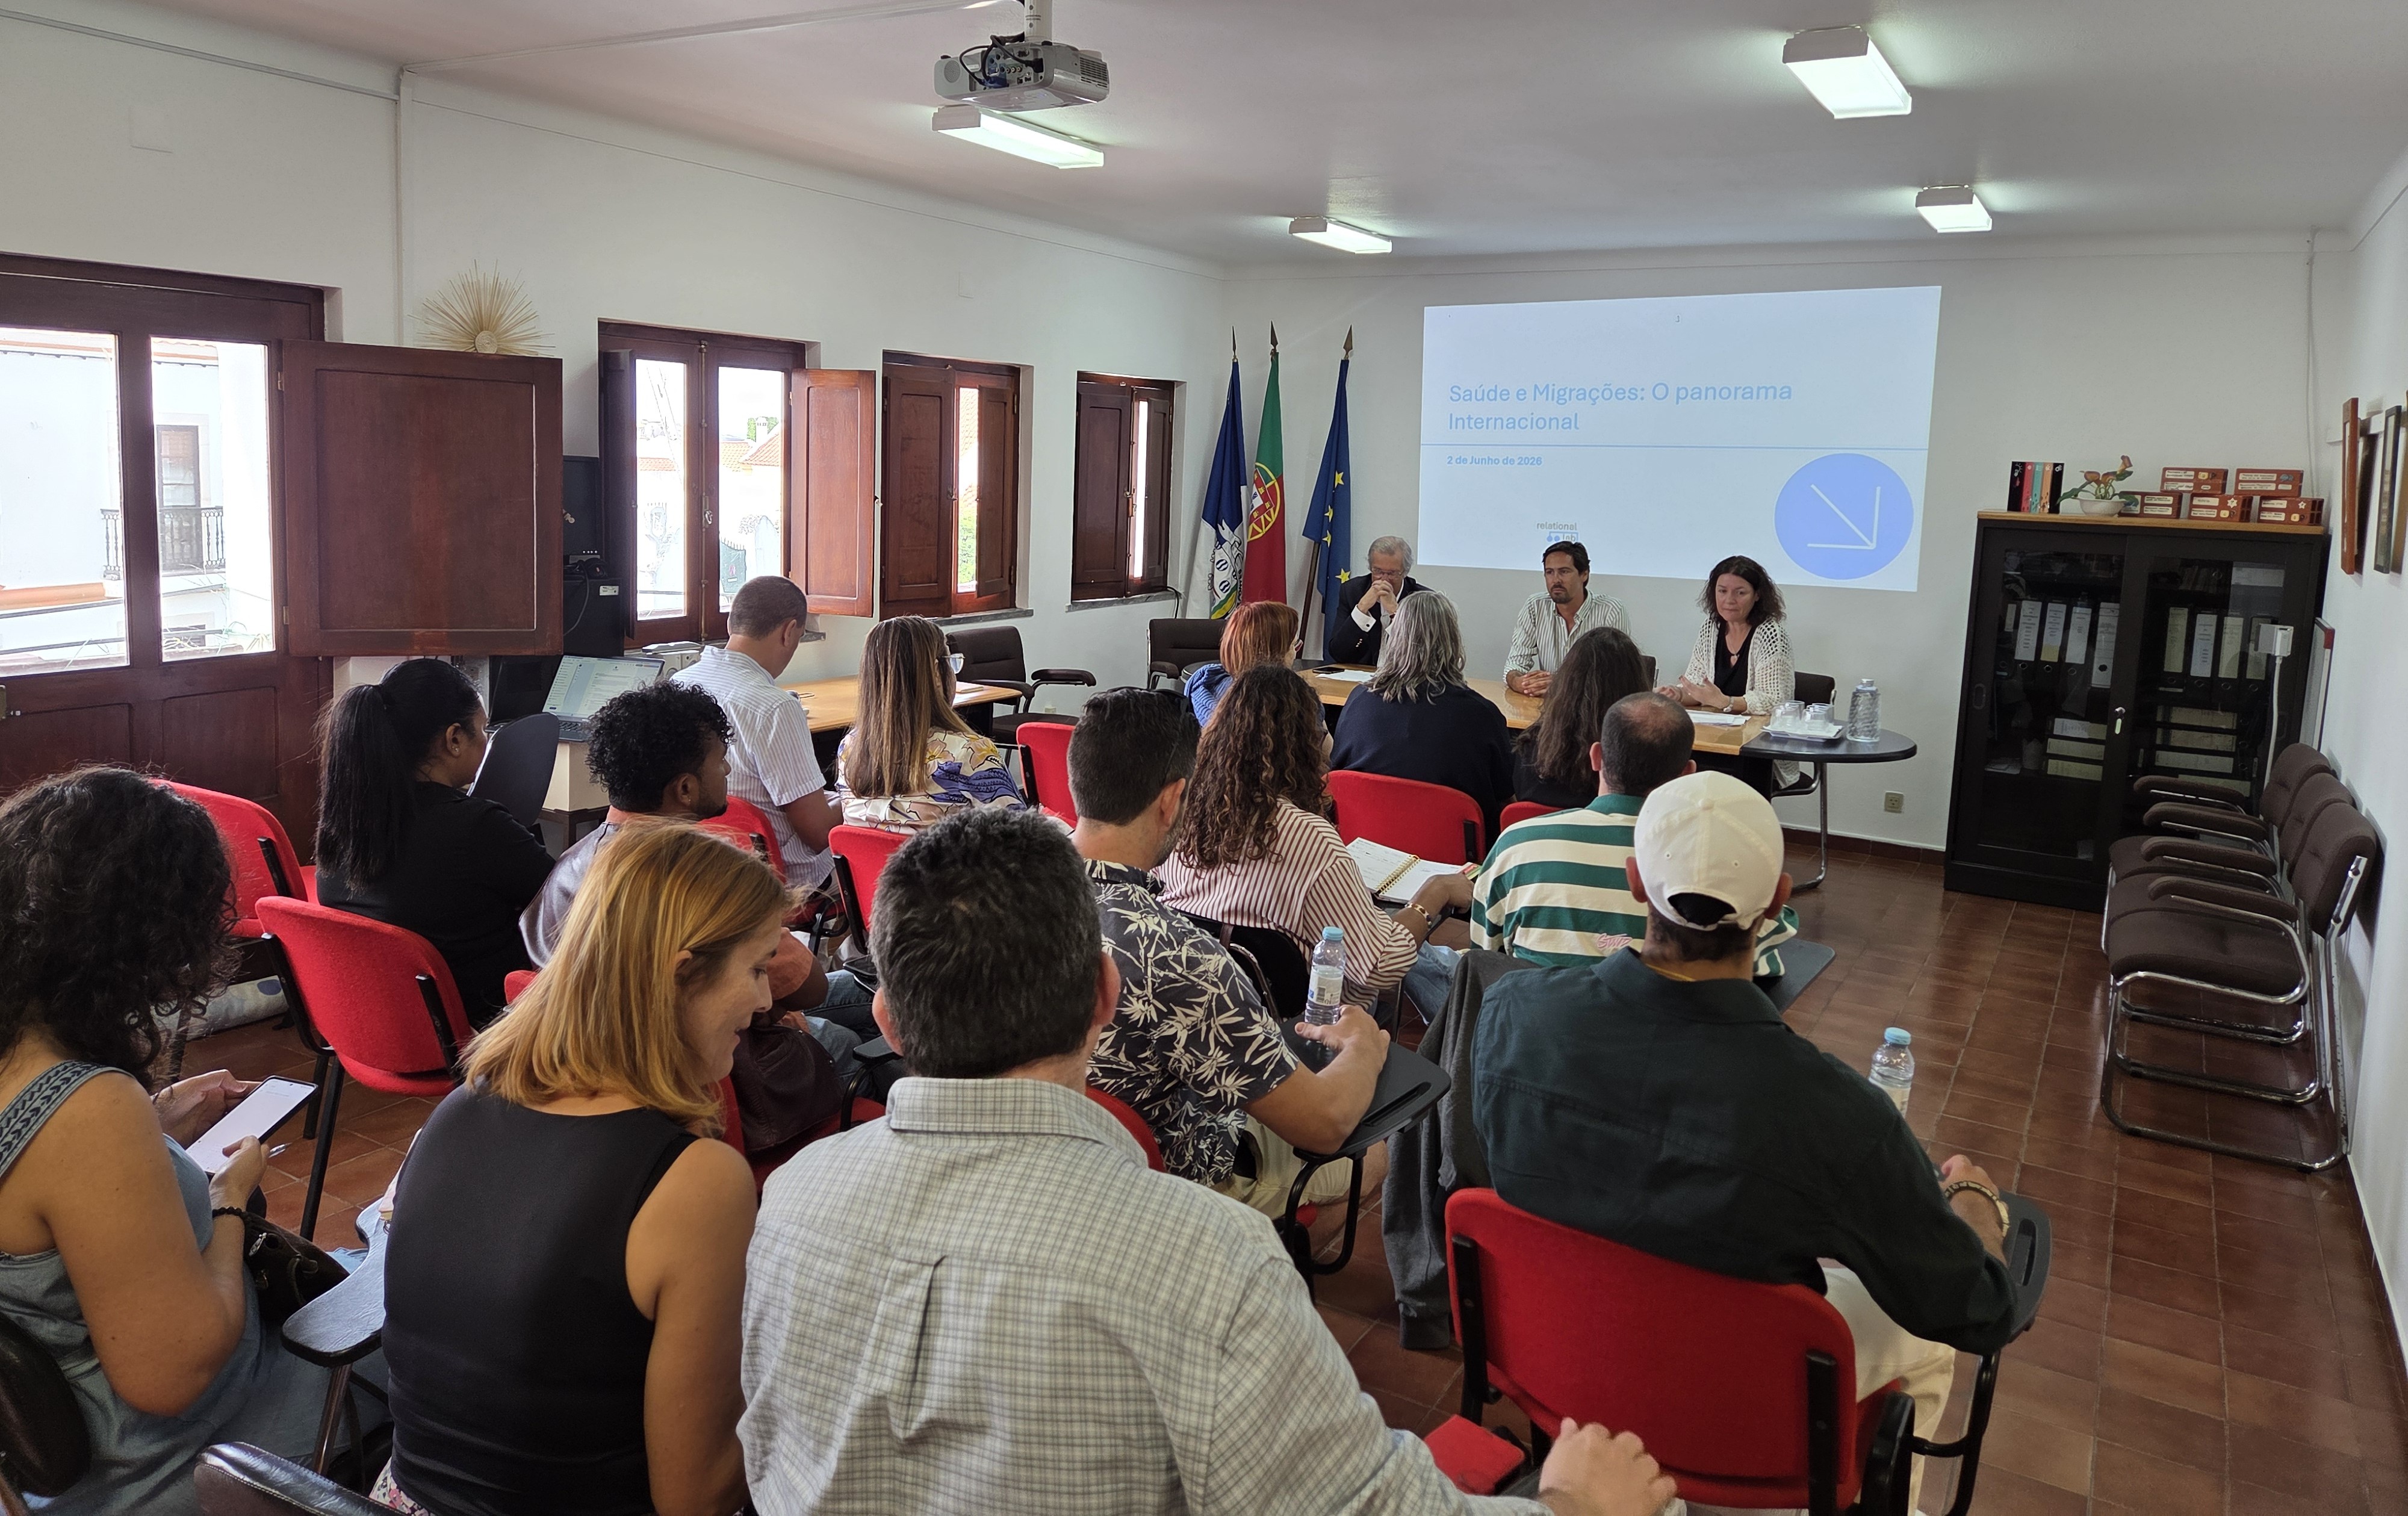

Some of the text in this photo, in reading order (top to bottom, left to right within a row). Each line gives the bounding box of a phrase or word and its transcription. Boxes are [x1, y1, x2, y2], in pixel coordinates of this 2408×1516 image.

[1449, 382, 1793, 406] Saúde e Migrações: O panorama
[1448, 412, 1580, 430] Internacional
[1447, 456, 1543, 466] 2 de Junho de 2026
[1536, 521, 1577, 530] relational
